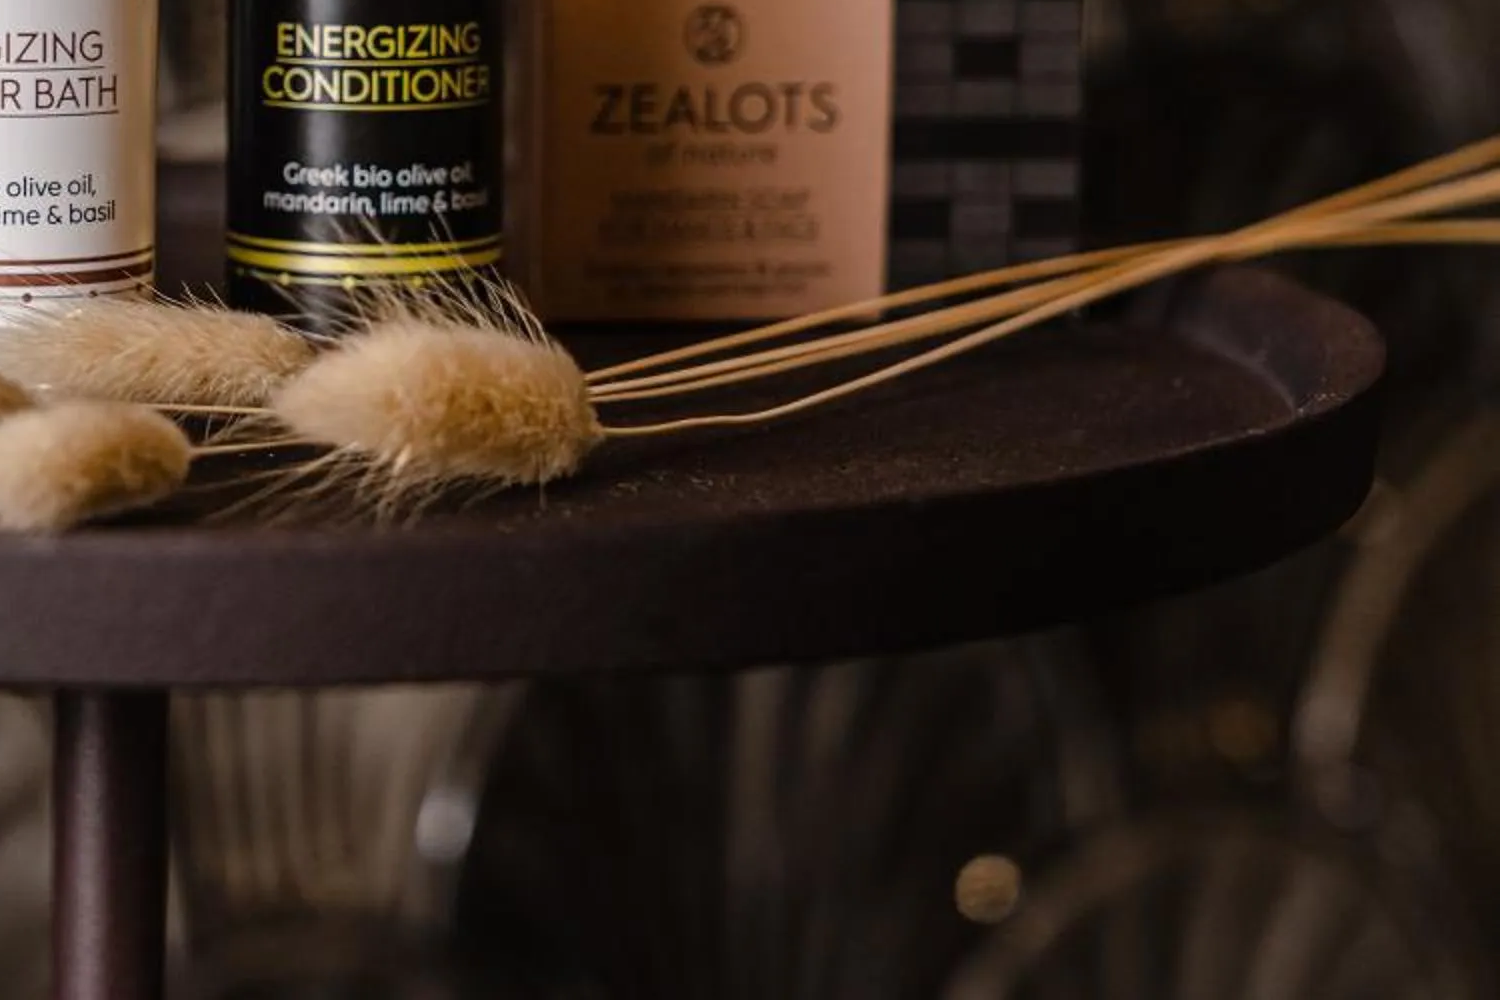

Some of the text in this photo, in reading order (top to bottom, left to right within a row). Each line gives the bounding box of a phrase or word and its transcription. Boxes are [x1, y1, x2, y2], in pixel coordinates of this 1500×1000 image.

[277, 22, 481, 59] ENERGIZING
[35, 73, 118, 110] BATH
[589, 83, 841, 135] ZEALOTS
[6, 176, 61, 198] olive
[67, 174, 97, 197] oil,
[283, 161, 349, 187] Greek
[353, 164, 392, 188] bio
[396, 163, 447, 187] olive
[47, 206, 63, 225] &
[69, 200, 116, 225] basil
[263, 190, 376, 217] mandarin,
[381, 192, 429, 215] lime
